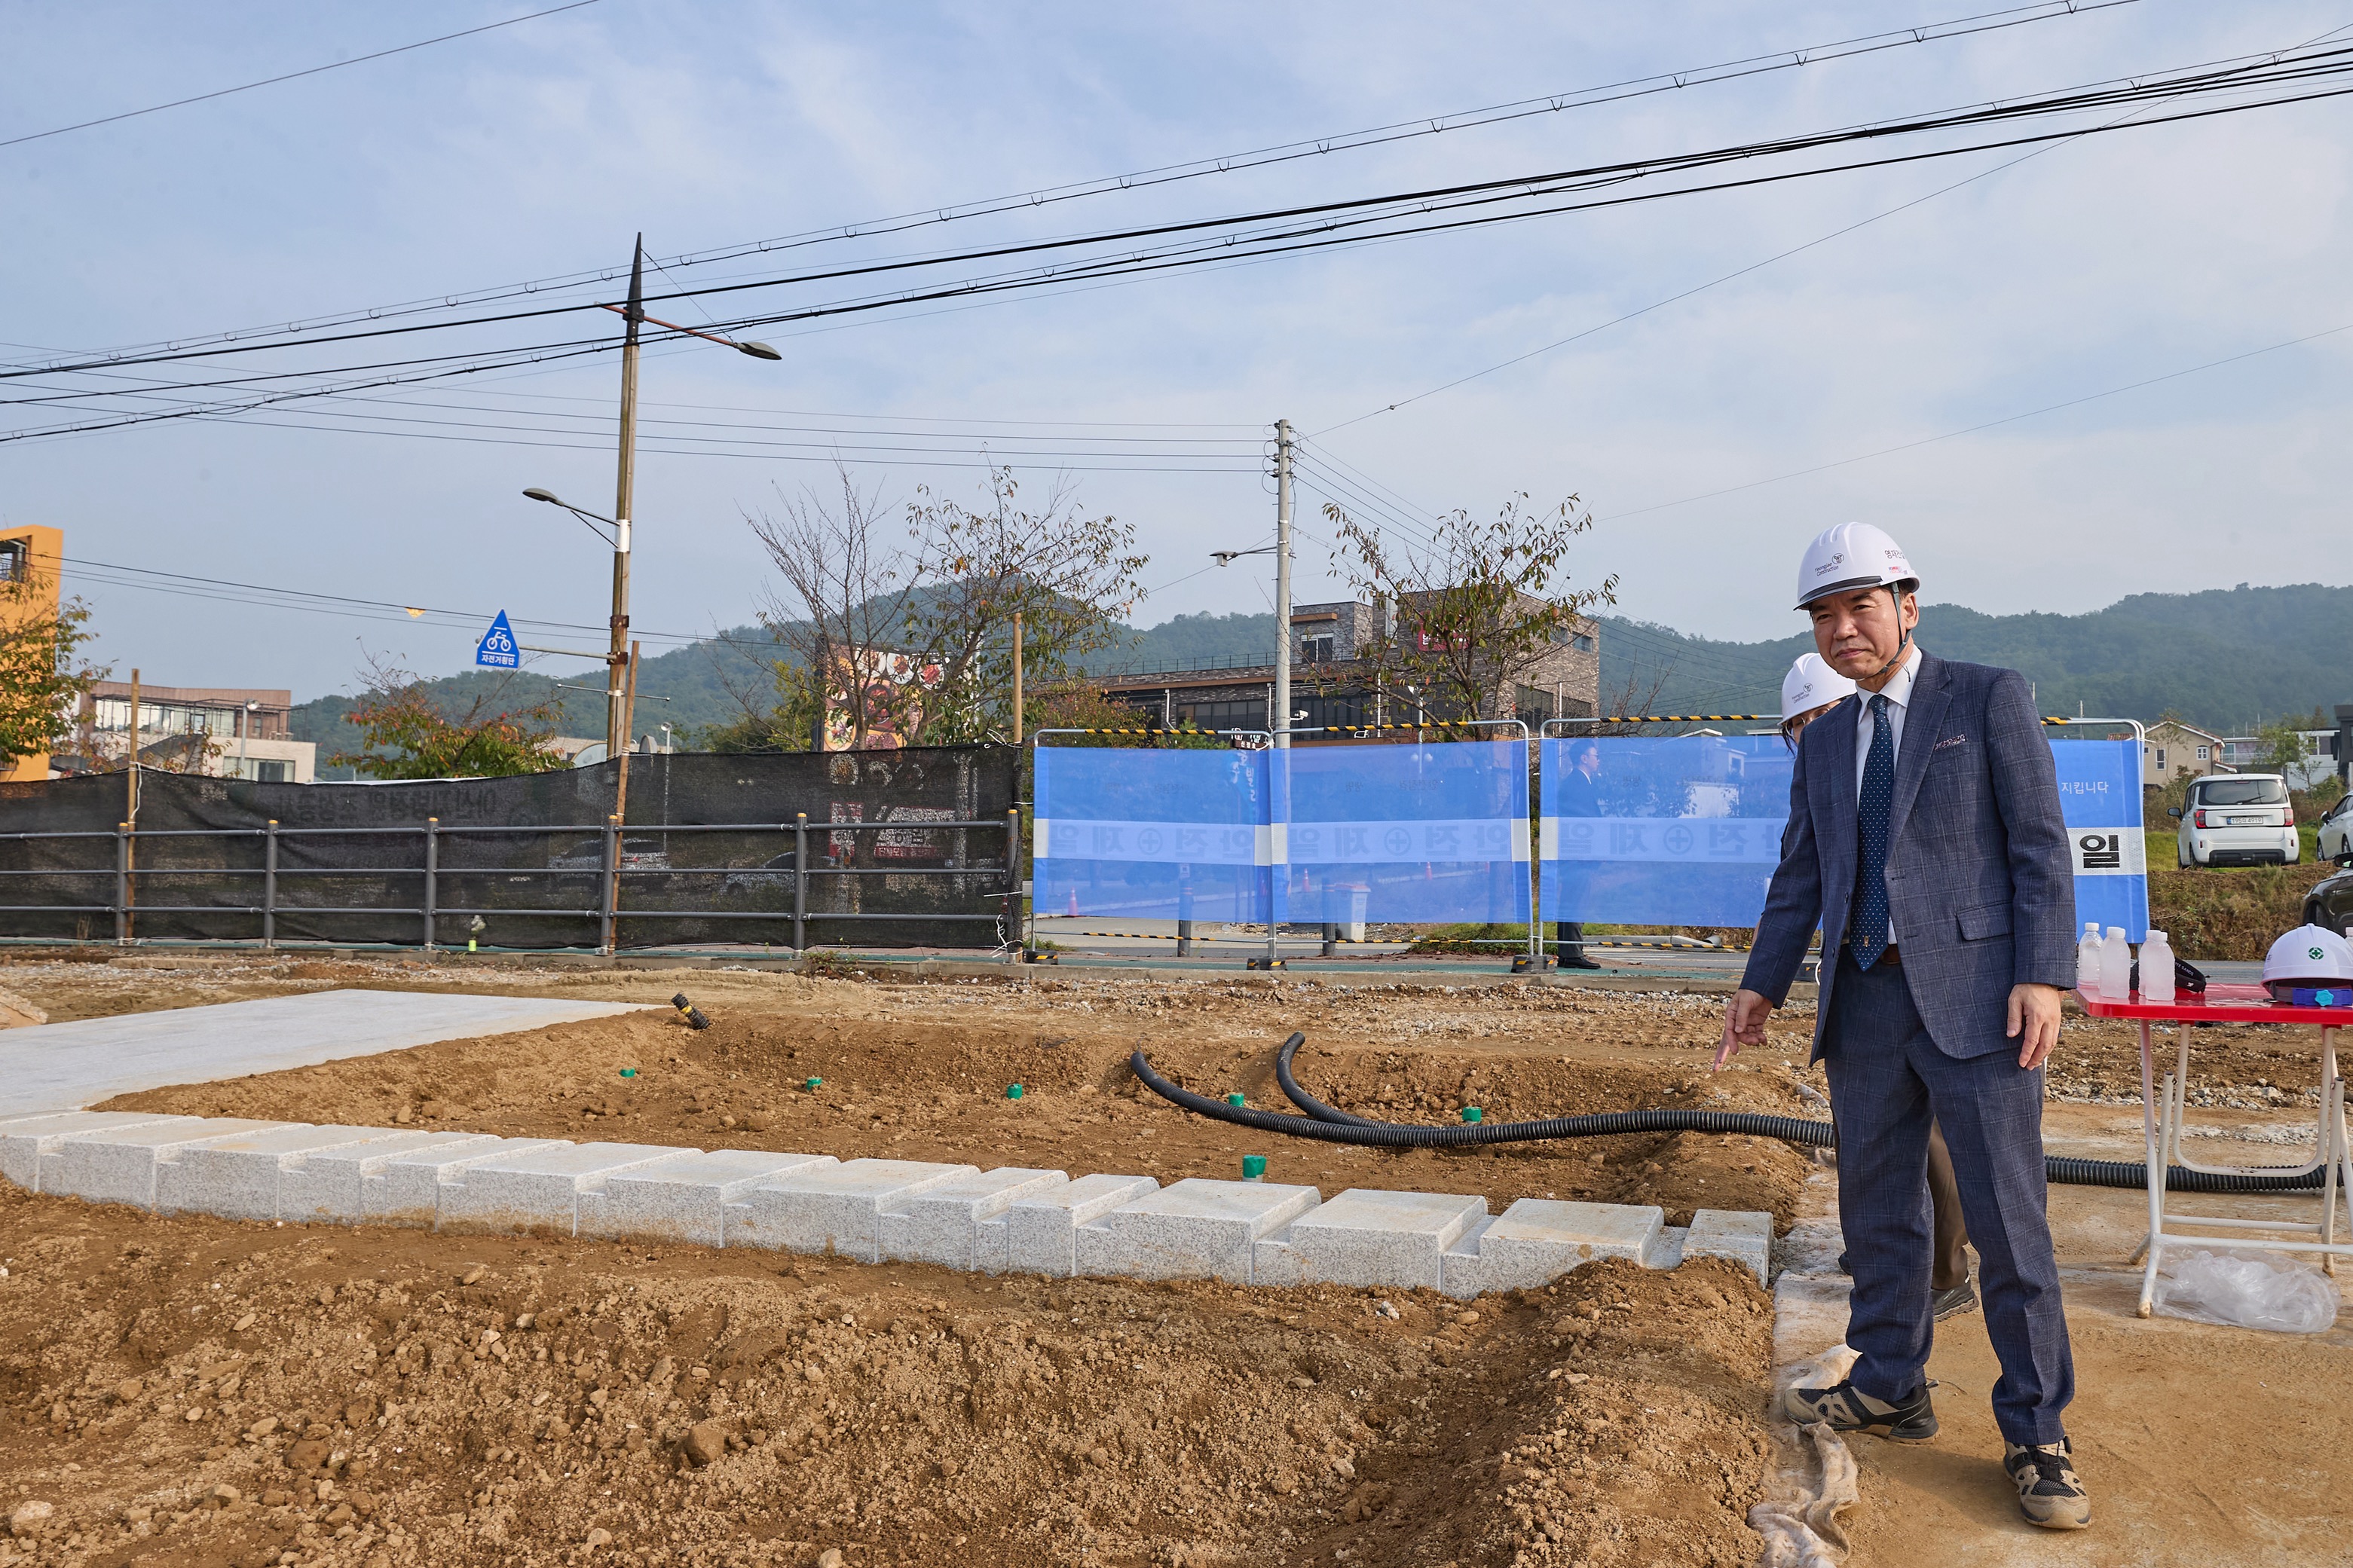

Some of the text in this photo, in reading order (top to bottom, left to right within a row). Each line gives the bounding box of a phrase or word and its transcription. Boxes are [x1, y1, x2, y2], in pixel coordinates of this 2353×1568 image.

[1816, 565, 1839, 577] Construction
[481, 654, 516, 665] 자전거횡단
[2061, 781, 2109, 794] 지킵니다
[2079, 834, 2120, 868] 일
